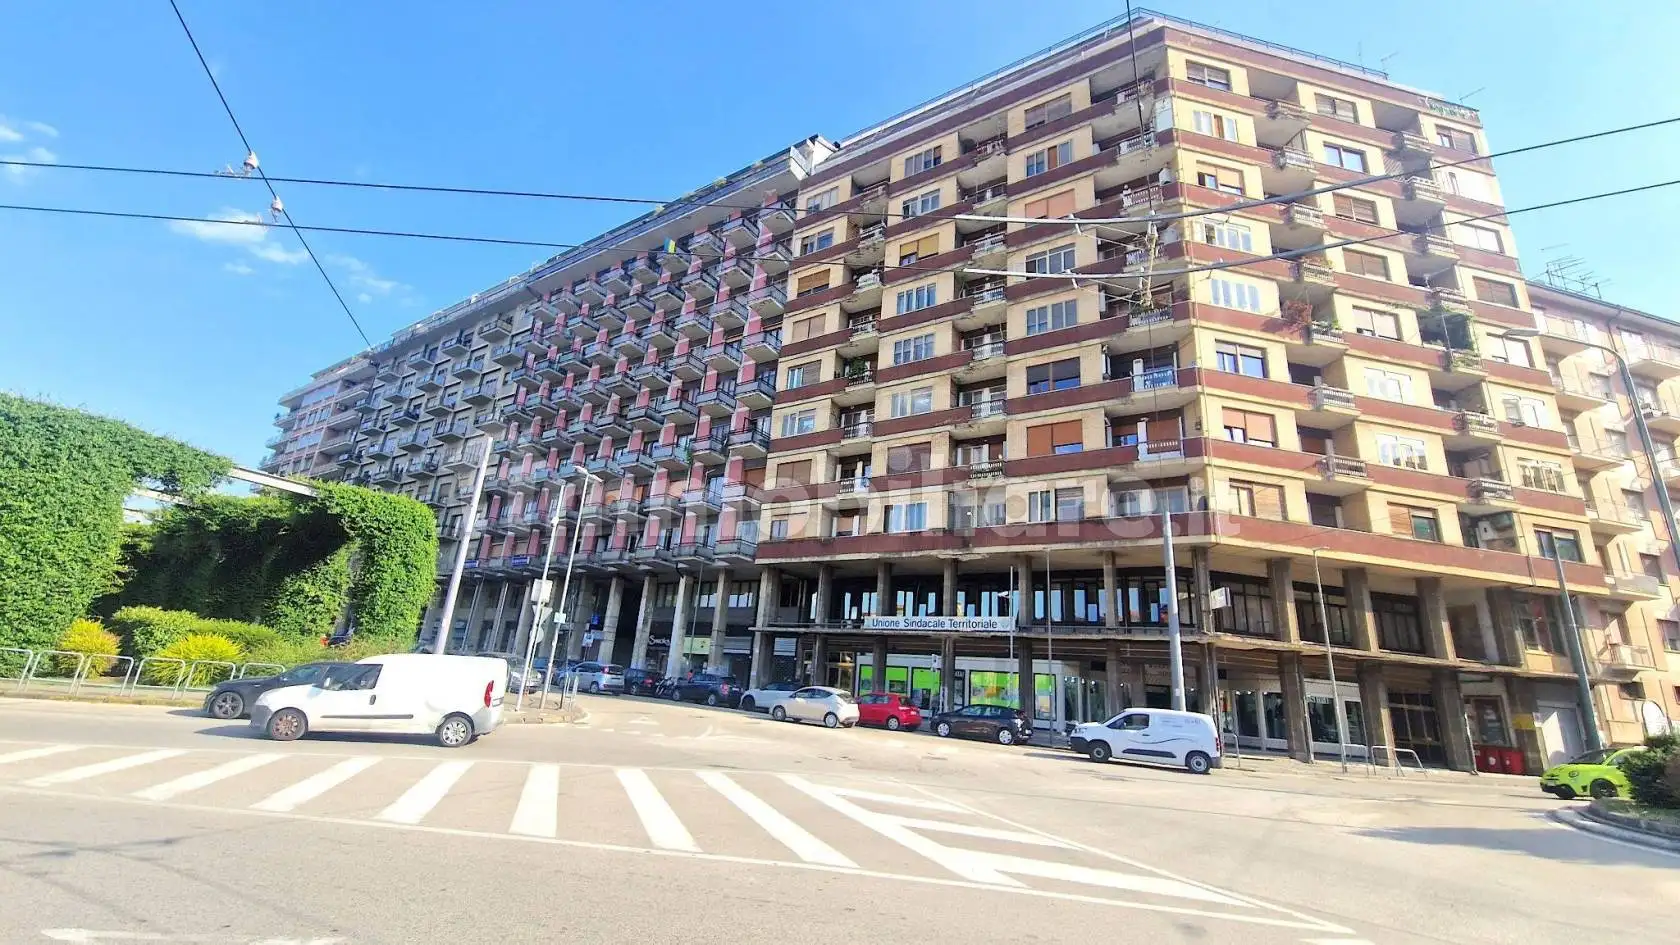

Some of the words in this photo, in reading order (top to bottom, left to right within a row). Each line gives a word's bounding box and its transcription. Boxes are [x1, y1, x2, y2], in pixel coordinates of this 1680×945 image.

[872, 618, 900, 628] Unione
[903, 618, 946, 629] Sindacale
[948, 618, 998, 629] Territoriale
